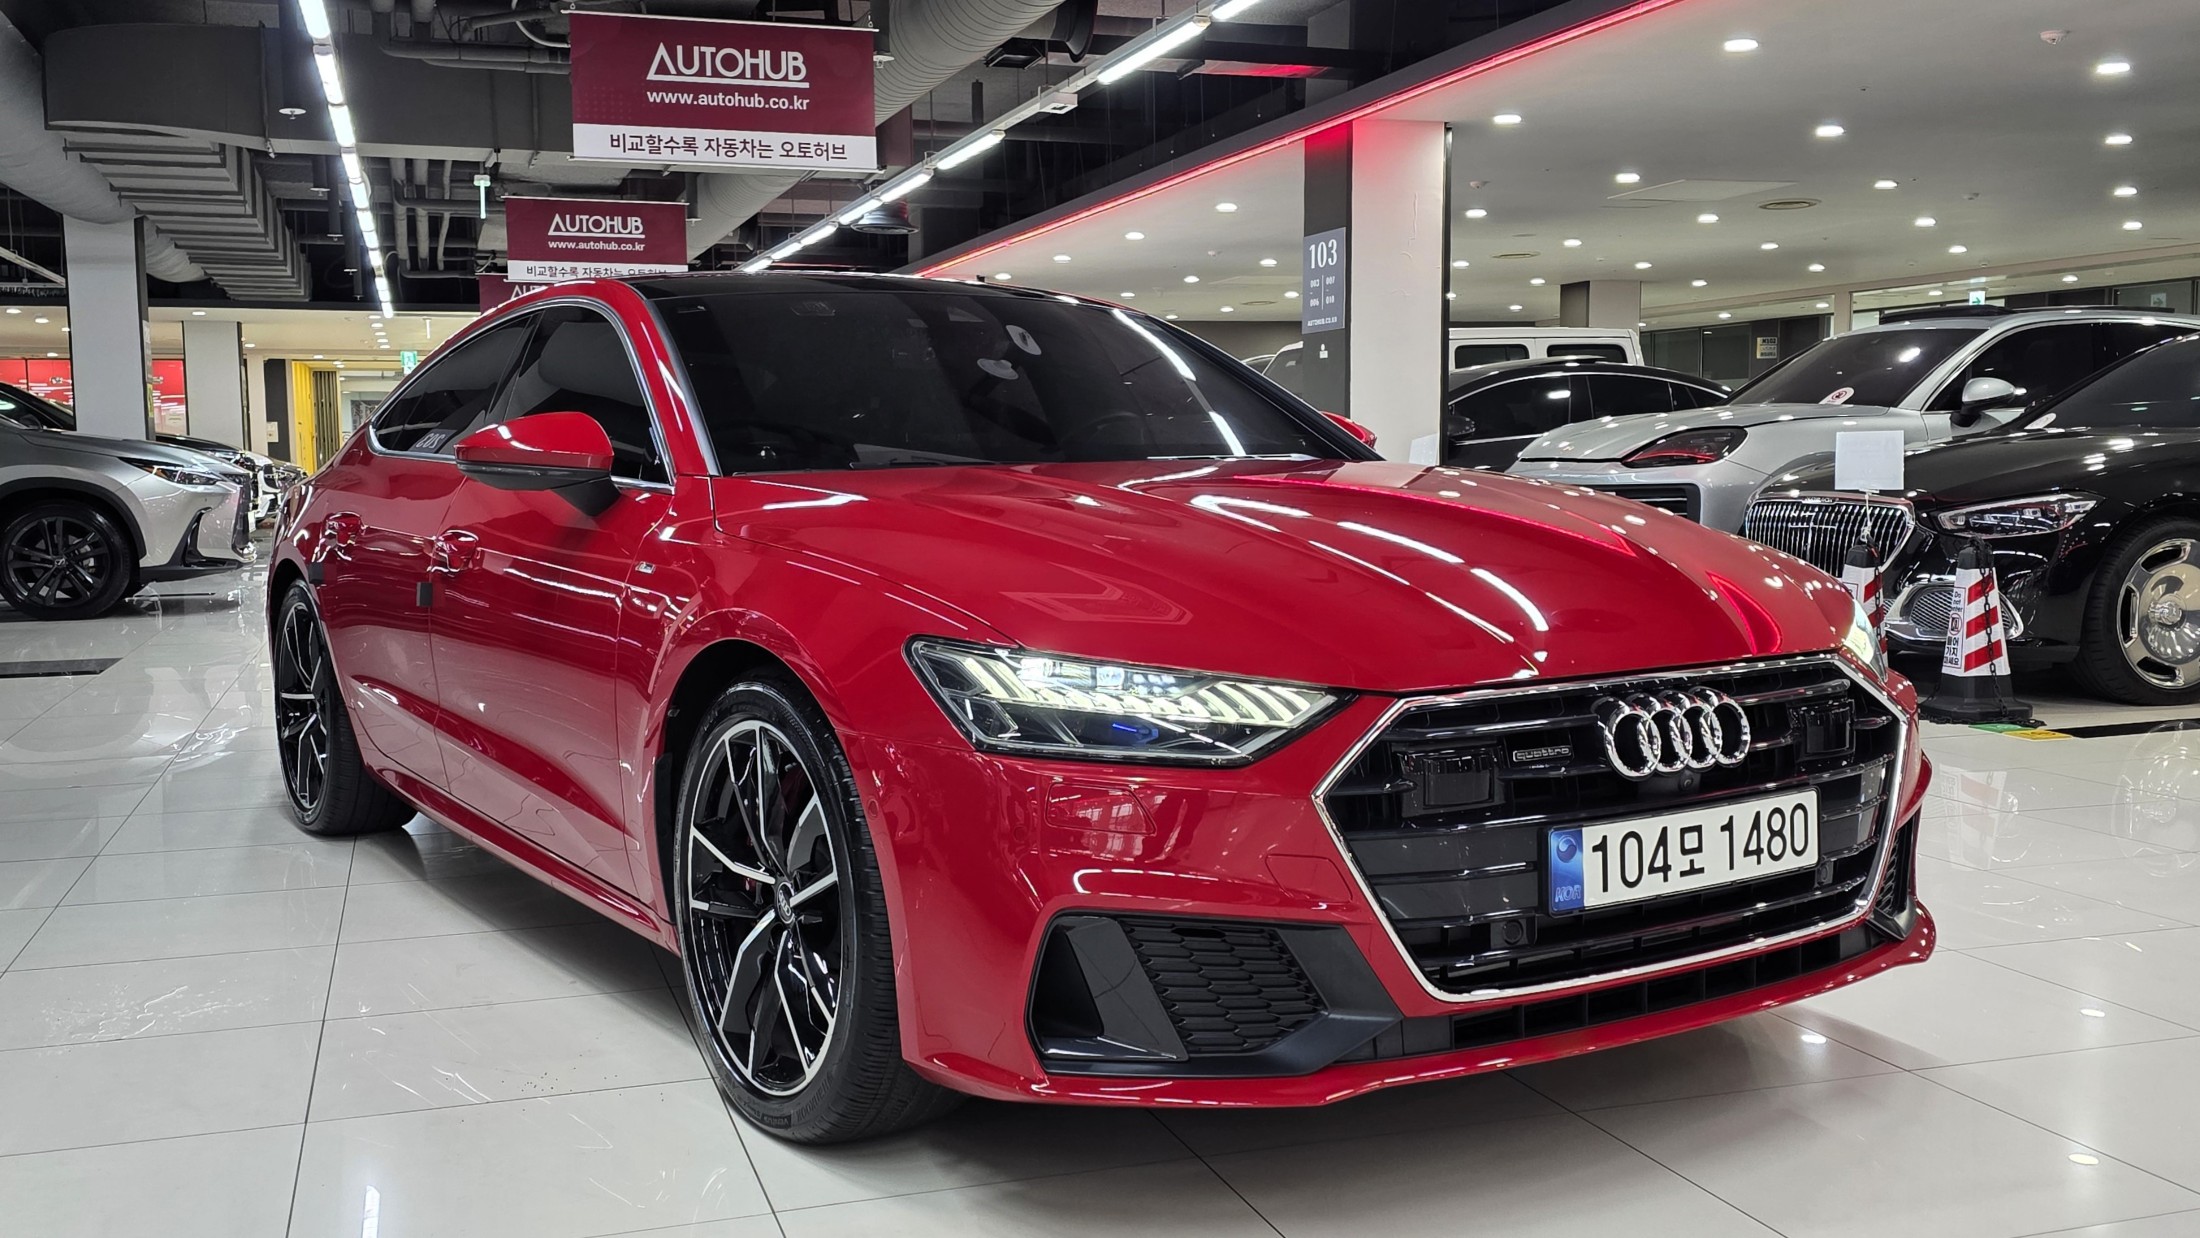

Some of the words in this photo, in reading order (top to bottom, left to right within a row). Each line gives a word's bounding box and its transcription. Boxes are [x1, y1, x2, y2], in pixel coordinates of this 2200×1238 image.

[646, 41, 810, 87] AUTOHUB
[647, 91, 810, 111] www.autohub.co.kr
[610, 133, 699, 157] 비교할수록
[704, 137, 774, 159] 자동차는
[779, 141, 847, 162] 오토허브
[548, 213, 645, 237] AUTOHUB
[548, 240, 645, 252] www.autohub.co.kr
[1309, 238, 1337, 269] 103
[526, 265, 579, 277] 비교할수록
[1516, 748, 1570, 761] quattro
[1591, 824, 1705, 893] 104모
[1720, 803, 1809, 870] 1480
[1555, 885, 1582, 903] KOR
